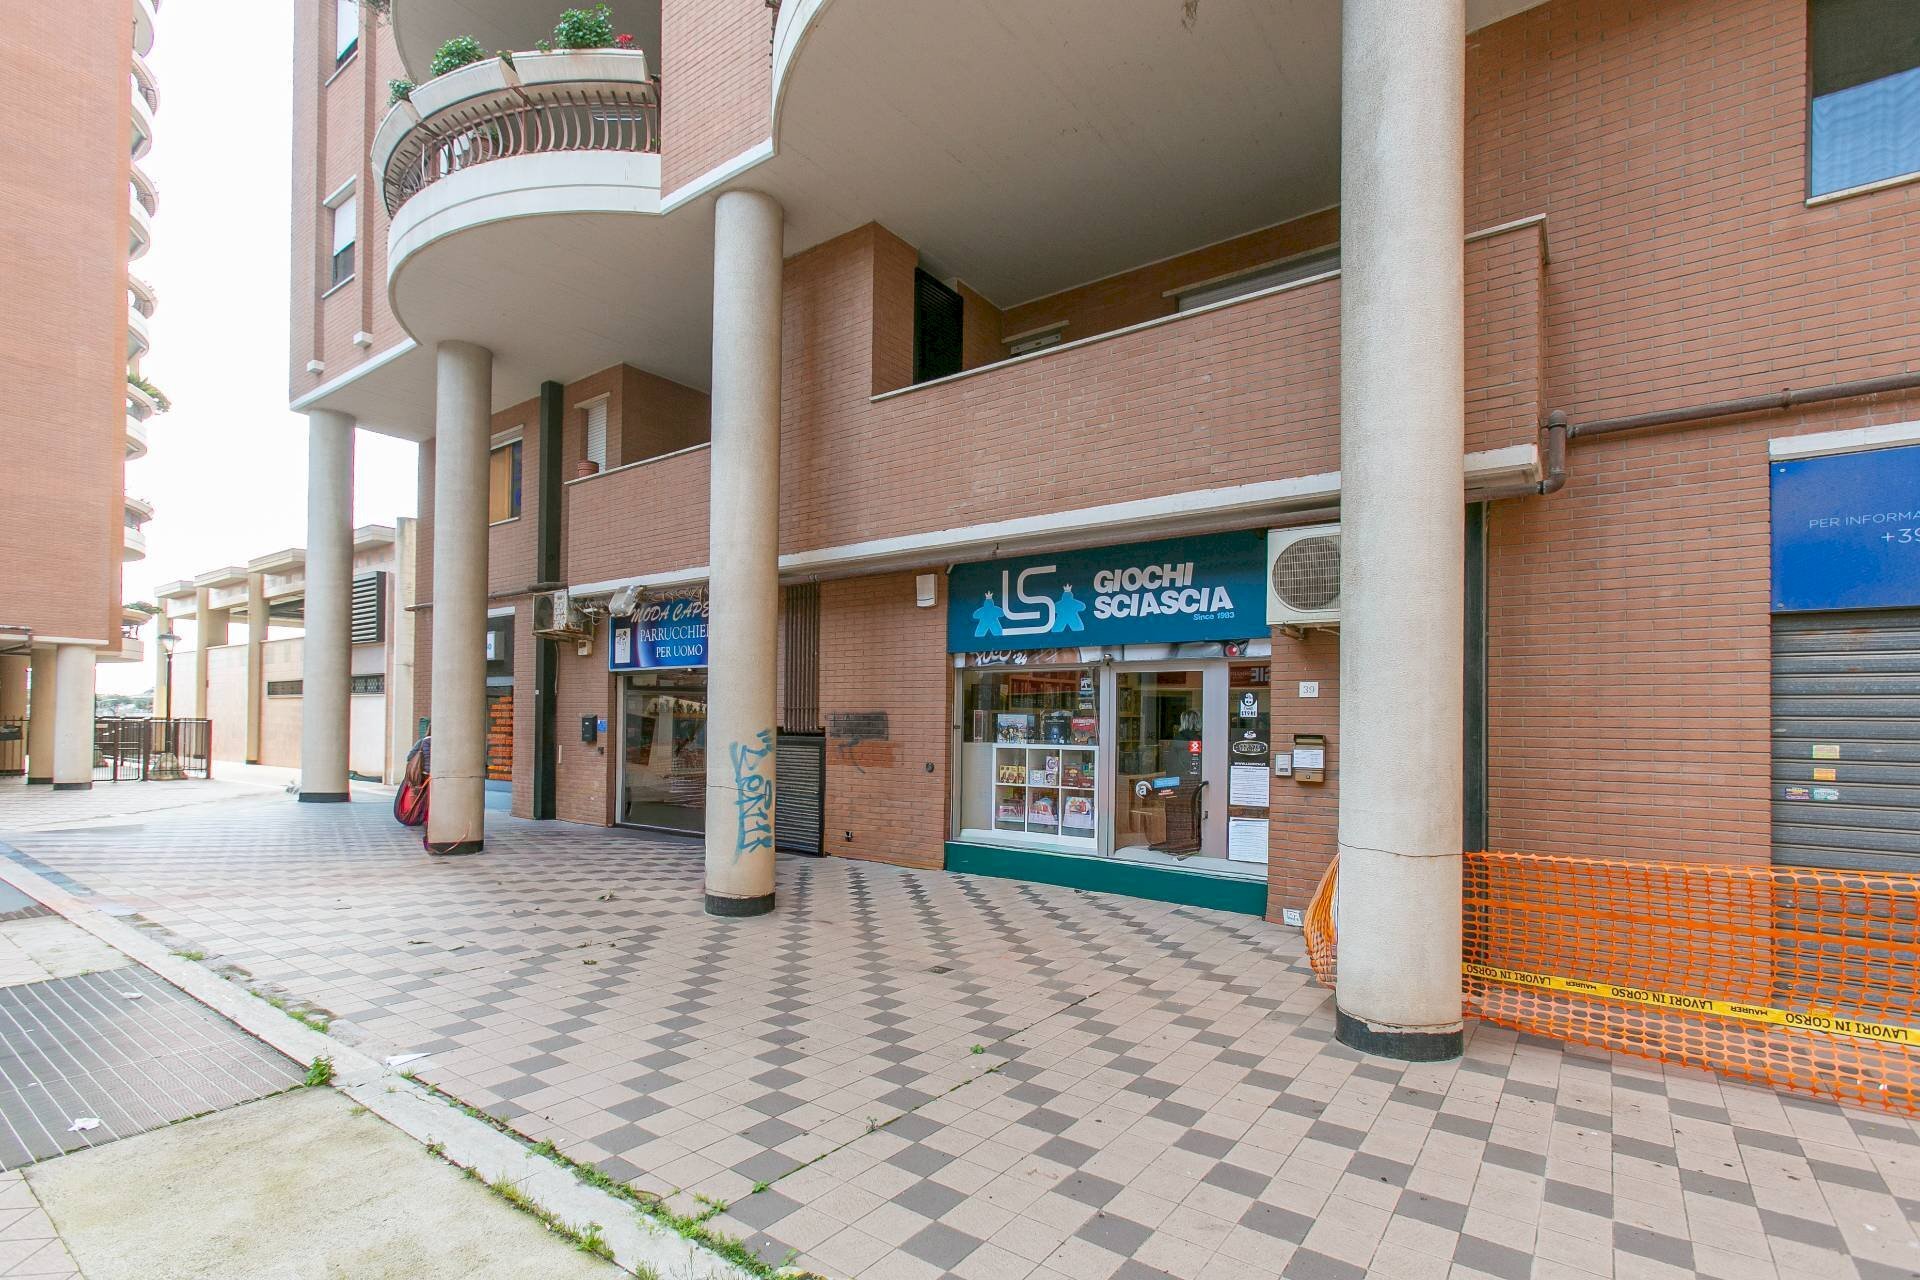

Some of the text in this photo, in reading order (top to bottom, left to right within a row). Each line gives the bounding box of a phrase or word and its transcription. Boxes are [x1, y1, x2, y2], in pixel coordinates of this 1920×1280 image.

[1808, 517, 1840, 529] PER
[1093, 562, 1194, 594] GIOCHI
[1002, 564, 1057, 636] LS
[1093, 586, 1234, 620] SCIASCIA
[631, 604, 670, 623] MODA
[1193, 613, 1214, 621] Since
[656, 643, 703, 658] PER UOMO
[1303, 685, 1315, 694] 39
[1466, 964, 1551, 986] LAVORI IN CORSO
[1565, 980, 1597, 990] MAURER
[1611, 987, 1713, 1011] LAVORI IN CORSO
[1730, 1006, 1768, 1016] MAURER
[1785, 1013, 1908, 1041] LAVORI IN CORSO
